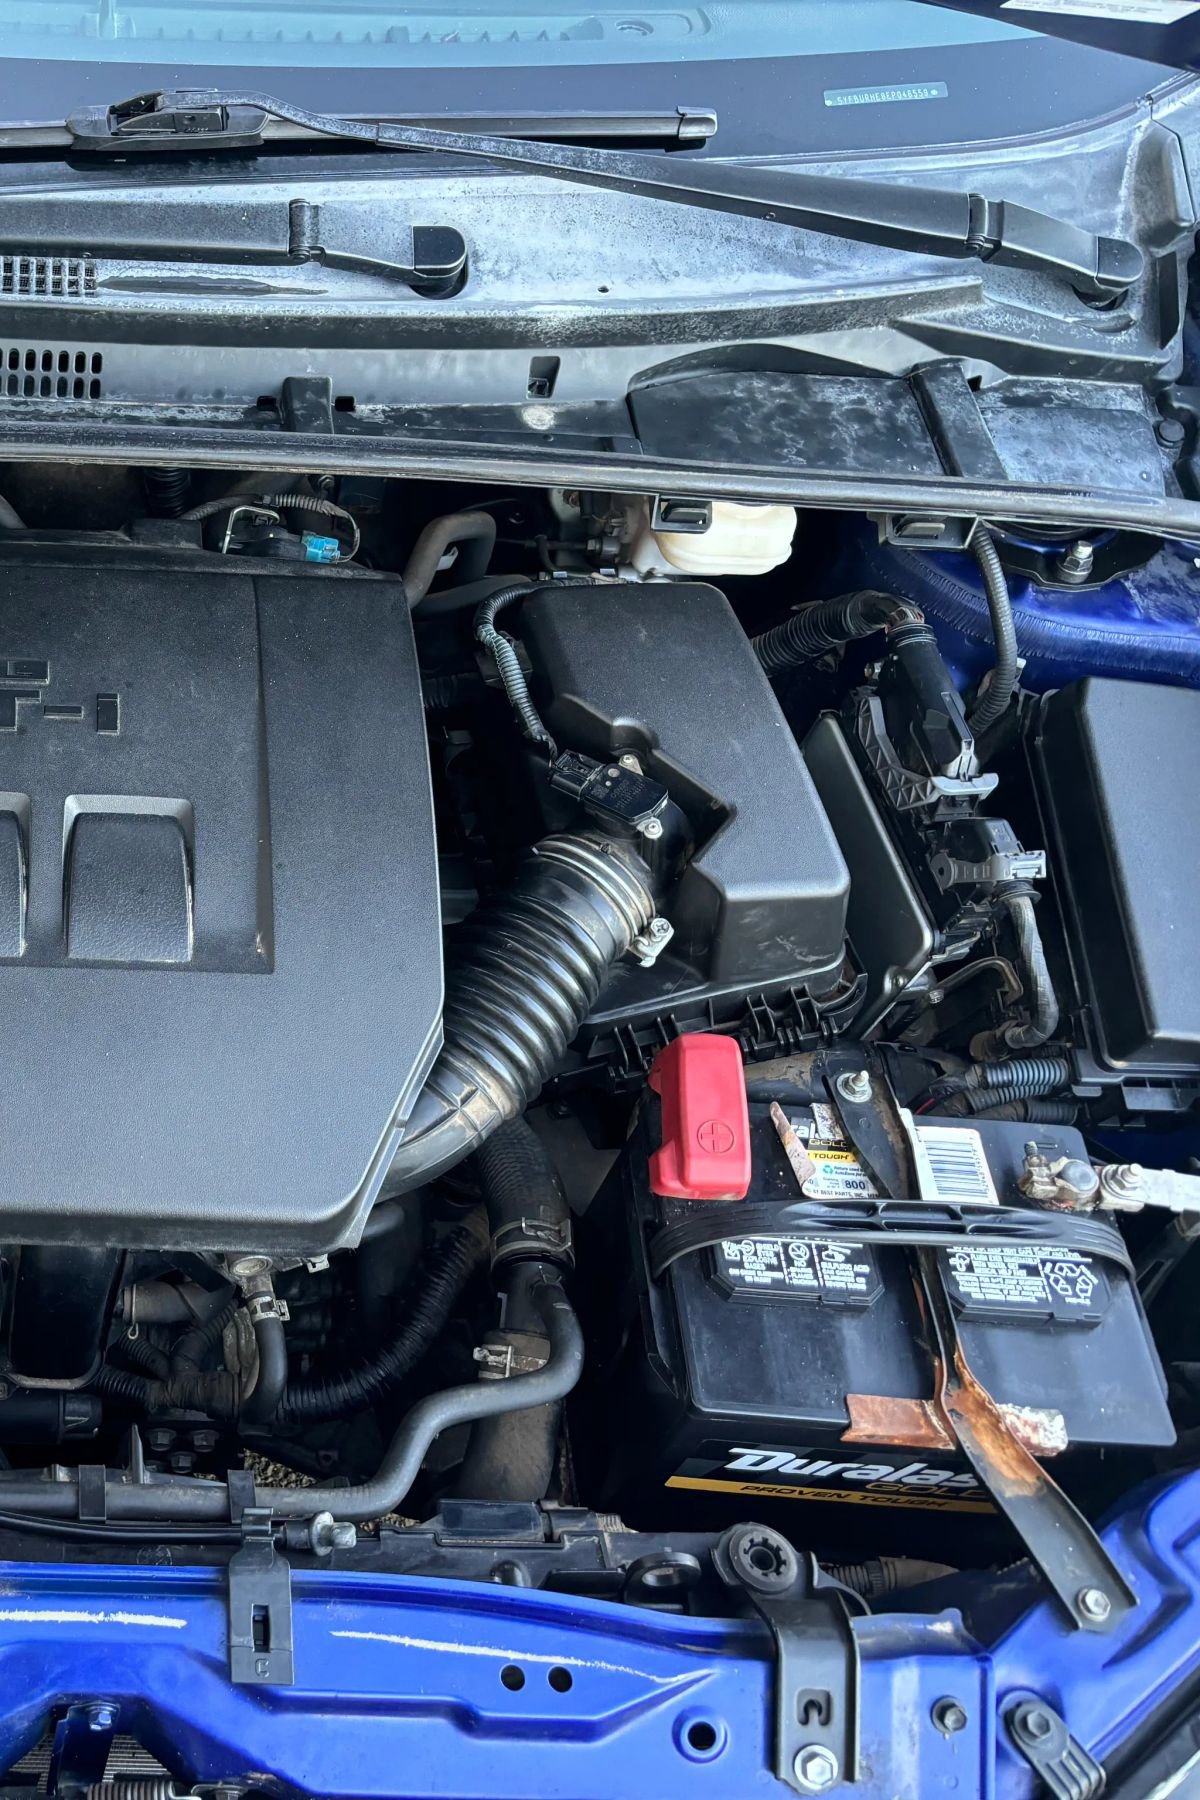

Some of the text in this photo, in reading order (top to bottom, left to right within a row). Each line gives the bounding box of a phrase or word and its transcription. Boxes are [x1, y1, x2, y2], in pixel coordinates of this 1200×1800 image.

[813, 1152, 849, 1160] TOUGH
[845, 1180, 866, 1190] 800
[724, 1447, 980, 1487] Duralas
[740, 1485, 949, 1508] PROVEN TOUGH
